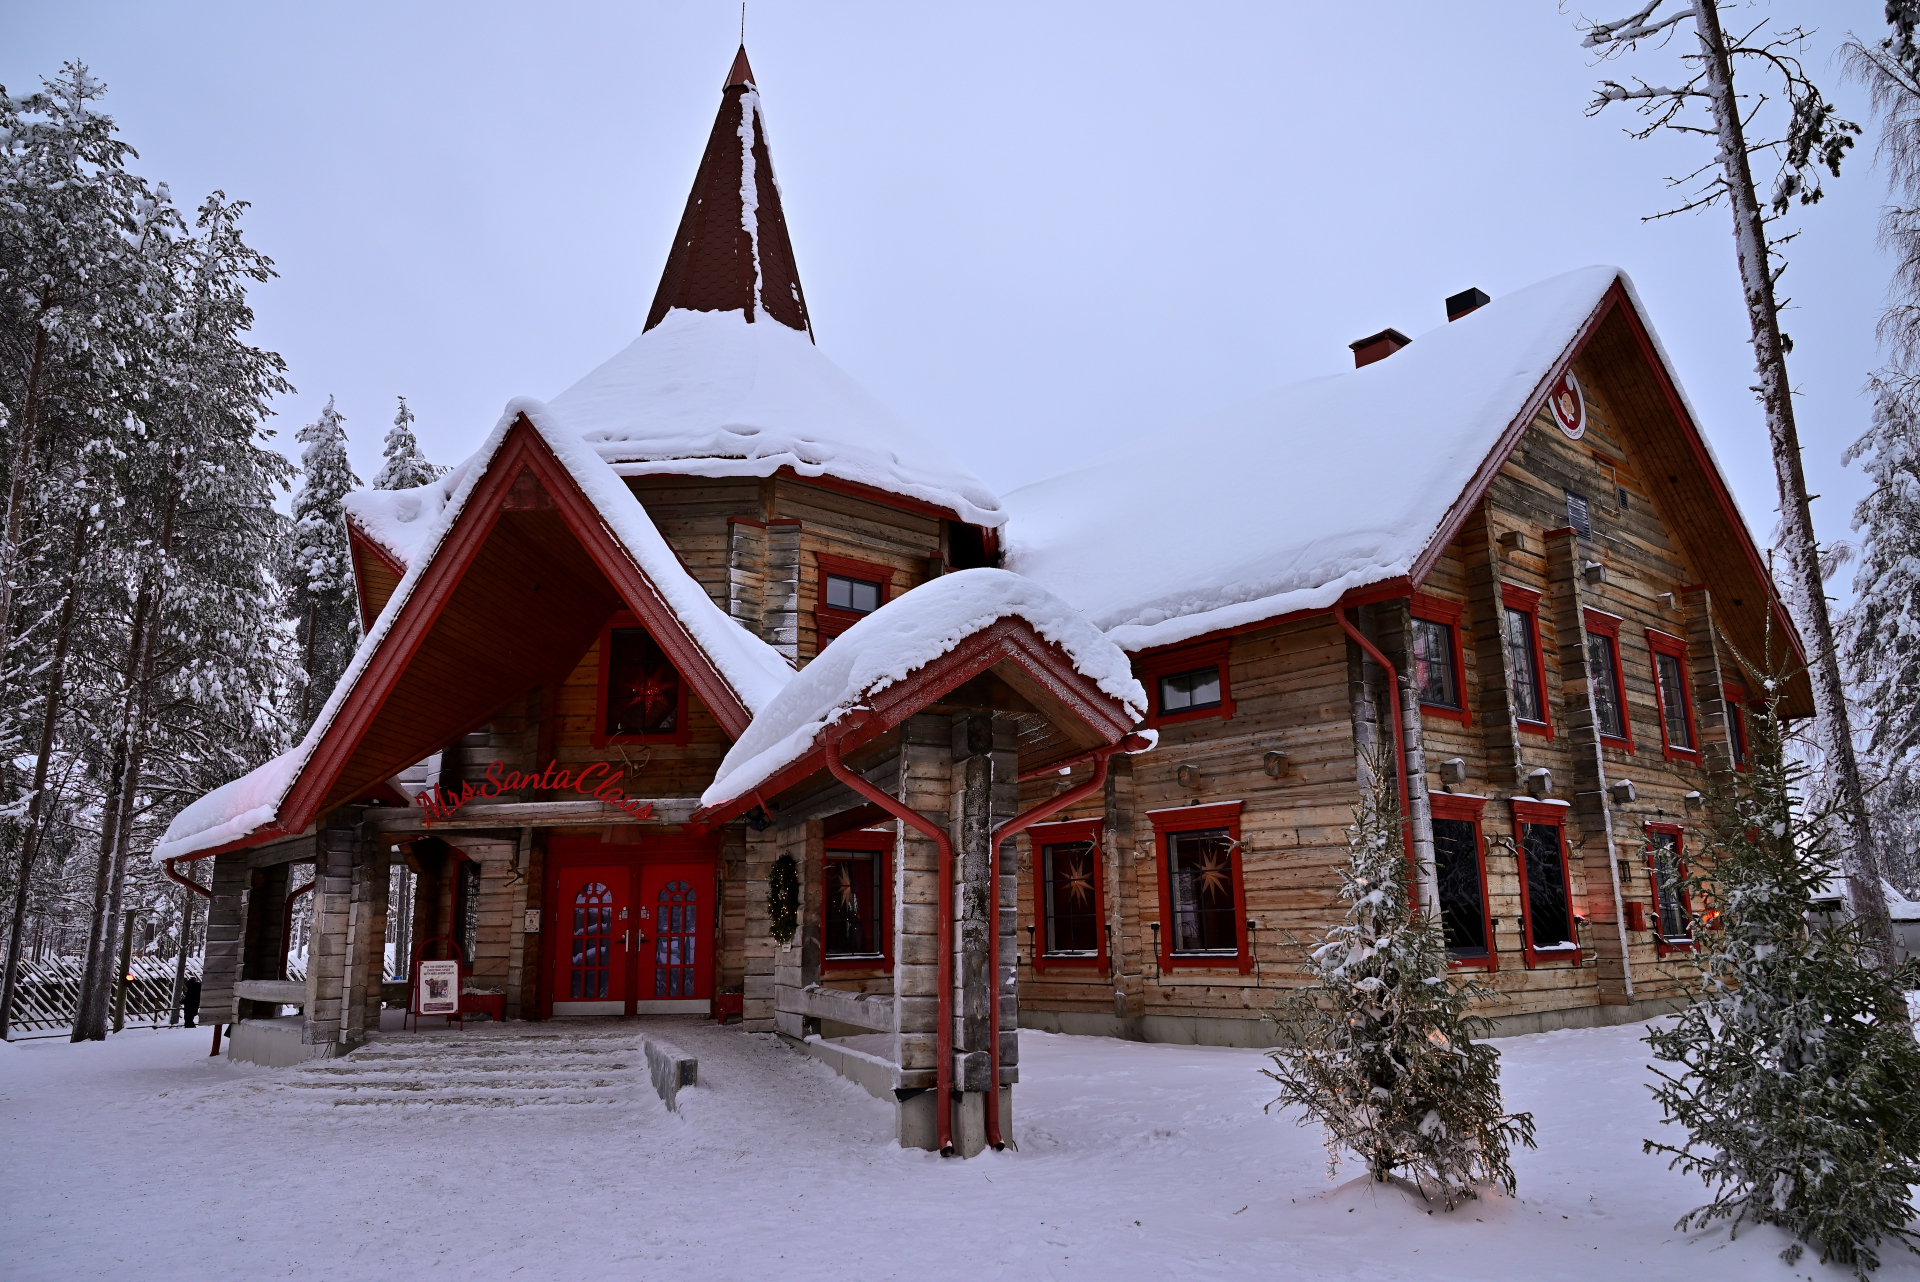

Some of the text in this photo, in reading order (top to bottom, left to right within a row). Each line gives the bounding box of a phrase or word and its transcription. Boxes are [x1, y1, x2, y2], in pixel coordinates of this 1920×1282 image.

[416, 759, 657, 829] Mrs. Santa Claus
